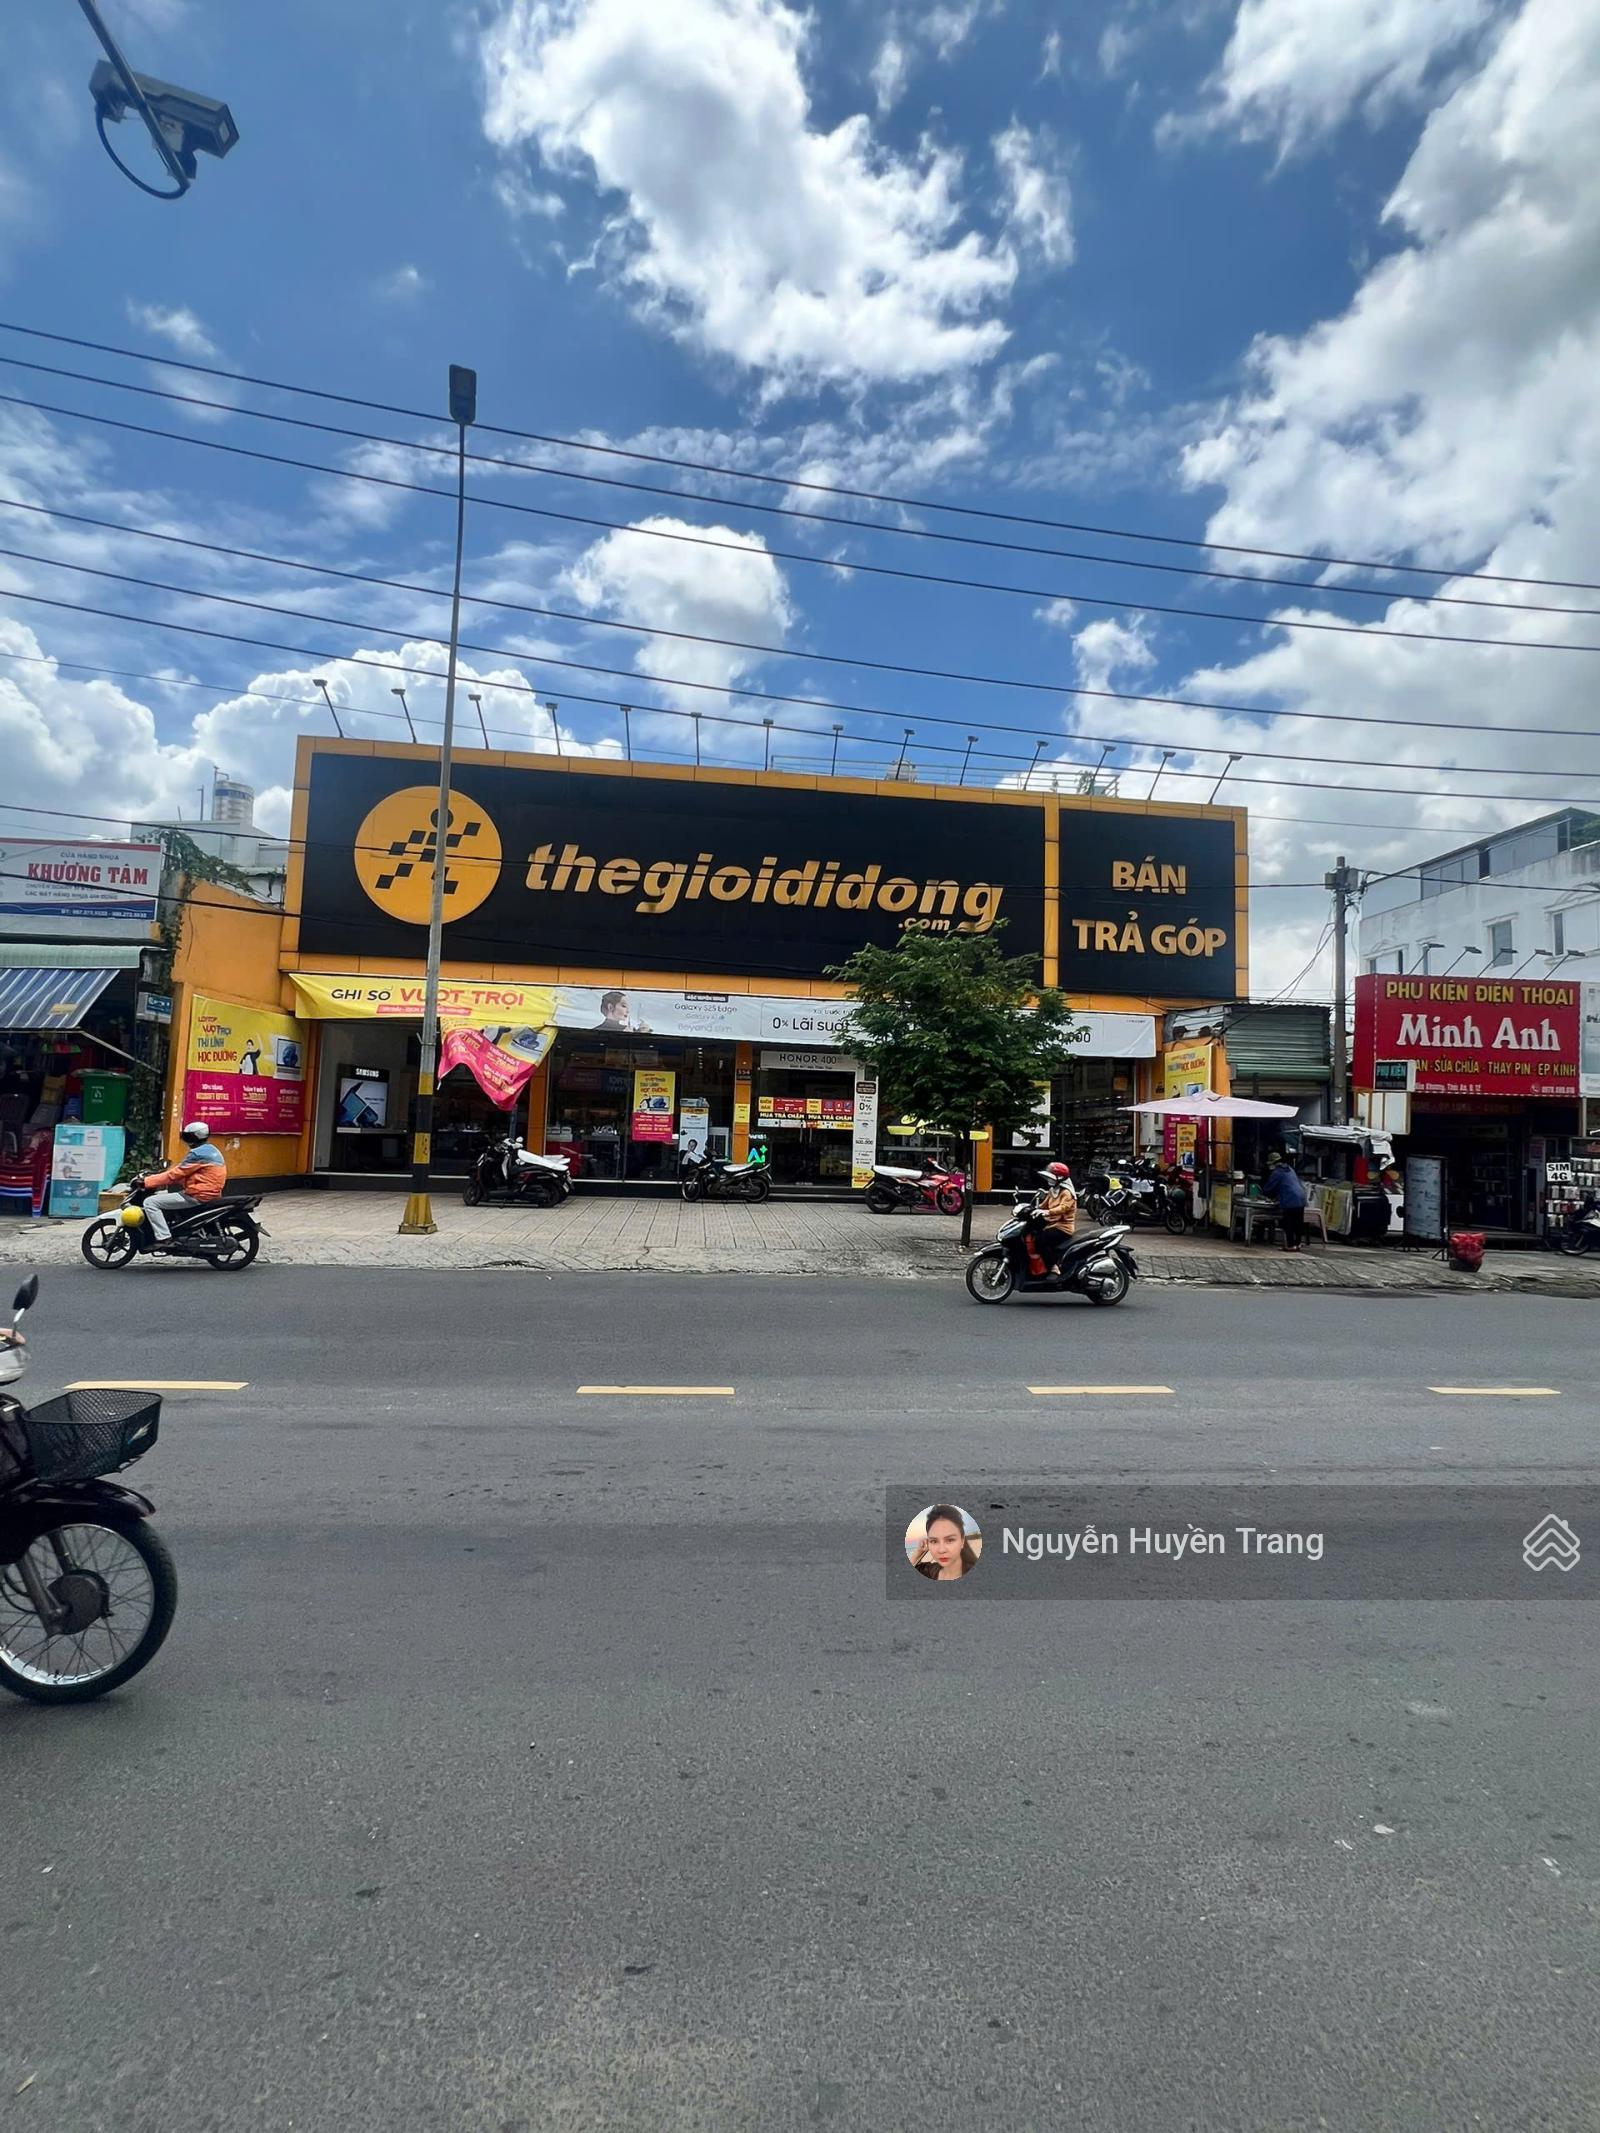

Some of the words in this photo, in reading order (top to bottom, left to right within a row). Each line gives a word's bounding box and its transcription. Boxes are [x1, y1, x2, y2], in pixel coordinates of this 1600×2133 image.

[28, 860, 101, 882] KHƯƠNG
[108, 863, 148, 885] TÂM
[1112, 856, 1186, 894] BÁN
[526, 843, 1003, 932] thegioididong
[898, 917, 950, 931] .com
[1072, 911, 1145, 953] TRẢ
[1151, 918, 1227, 957] GÓP
[331, 988, 362, 1001] GHI
[472, 988, 524, 1009] TRỘI
[1386, 981, 1424, 1003] PHỤ
[1430, 980, 1468, 1005] KIỆN
[1475, 981, 1514, 1006] ĐIỆN
[1521, 986, 1574, 1008] THOẠI
[772, 1017, 788, 1029] 0%
[793, 1017, 813, 1031] Lãi
[1396, 1013, 1483, 1048] Minh
[1491, 1017, 1561, 1051] Anh
[779, 1054, 818, 1063] HONOR
[1488, 1061, 1512, 1074] THAY
[1515, 1062, 1530, 1075] PIN
[1548, 1163, 1570, 1171] SIM
[1551, 1172, 1568, 1180] 4G
